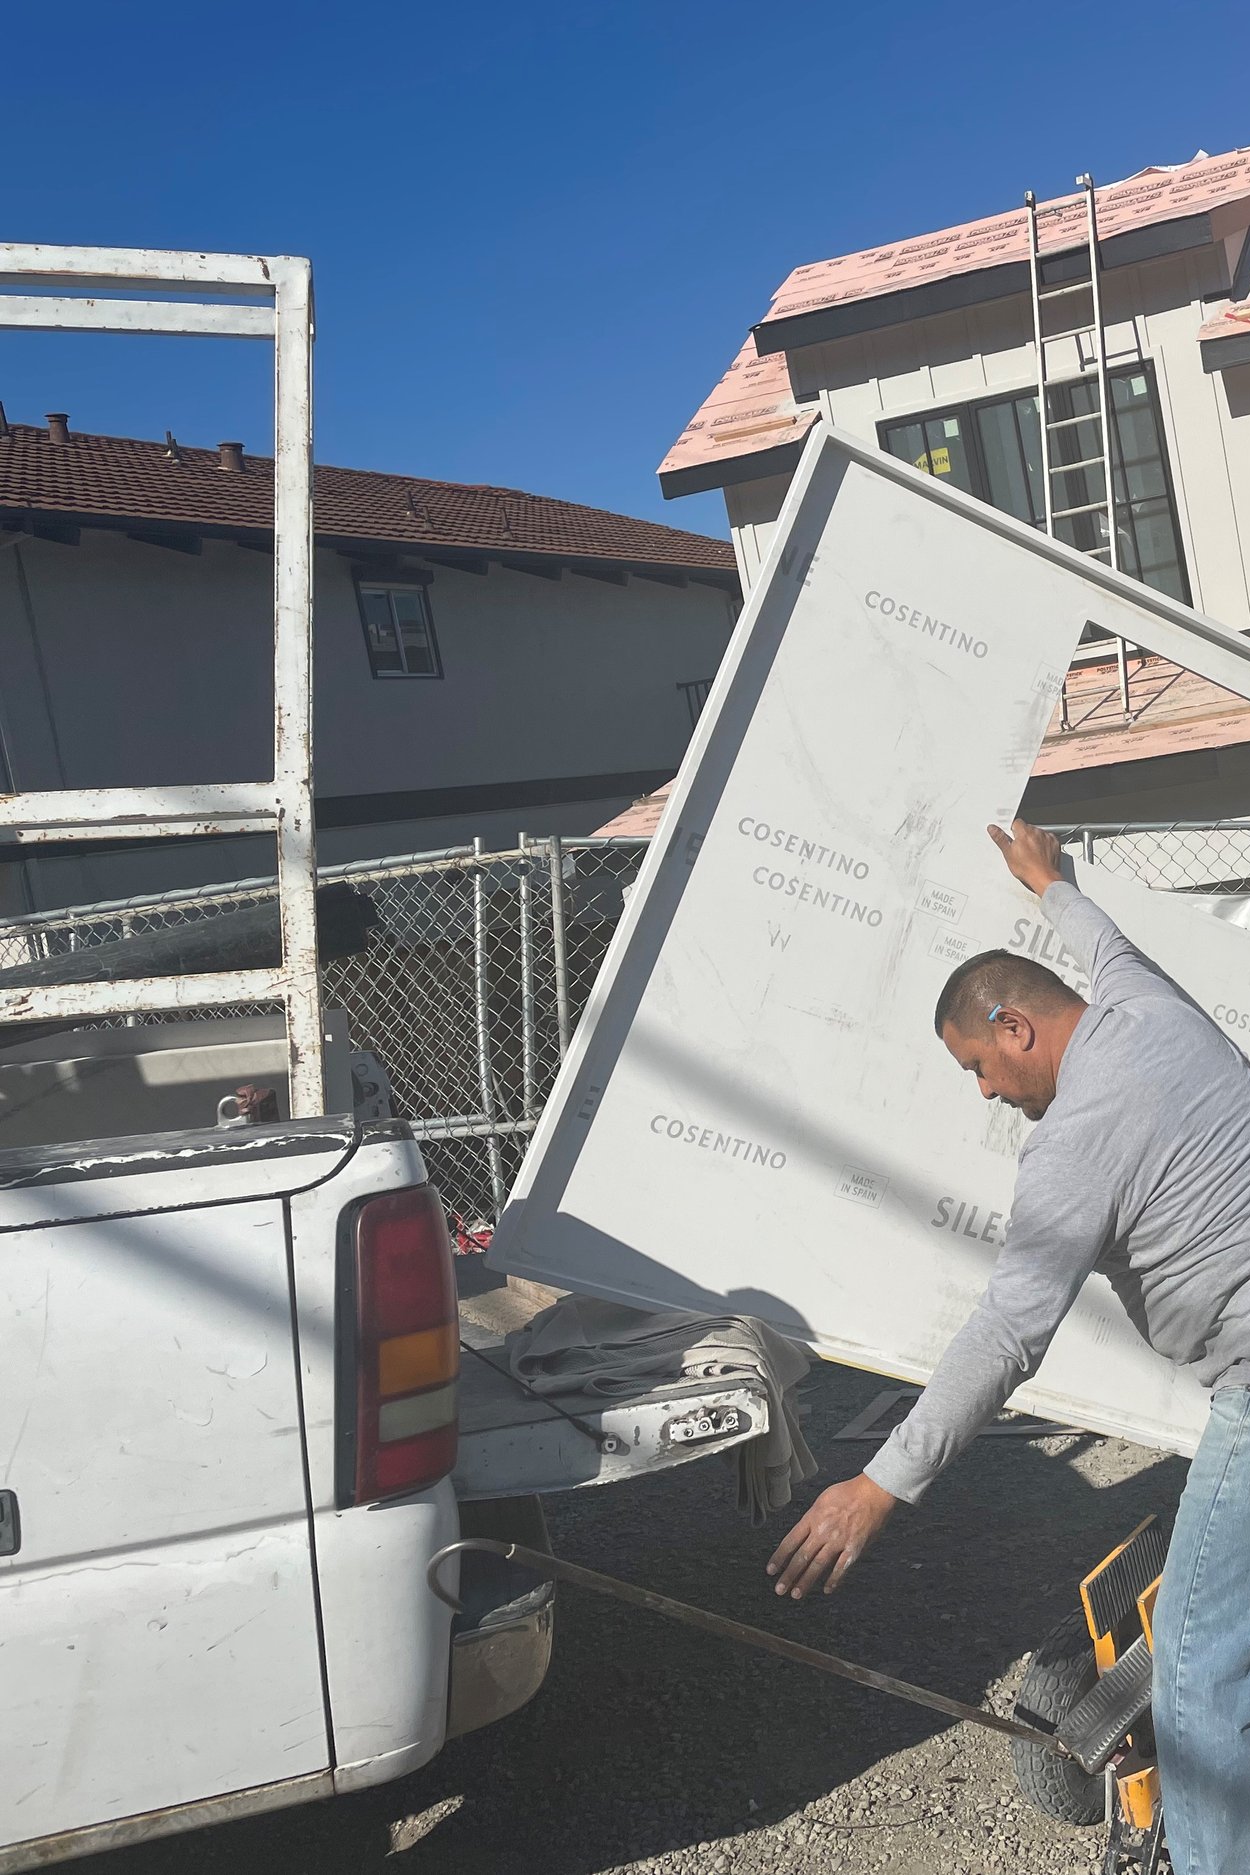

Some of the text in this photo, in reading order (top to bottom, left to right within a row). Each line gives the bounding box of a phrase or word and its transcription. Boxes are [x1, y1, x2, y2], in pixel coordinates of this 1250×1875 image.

[864, 590, 989, 659] COSENTINO
[738, 816, 870, 880] COSENTINO
[752, 866, 884, 927] COSENTINO
[930, 889, 955, 905] MADE
[921, 898, 957, 918] IN SPAIN
[934, 944, 944, 954] IN
[944, 936, 967, 951] MADE
[650, 1114, 787, 1169] COSENTINO
[851, 1174, 876, 1190] MADE
[840, 1183, 878, 1202] IN SPAIN
[931, 1196, 1005, 1248] SILE
